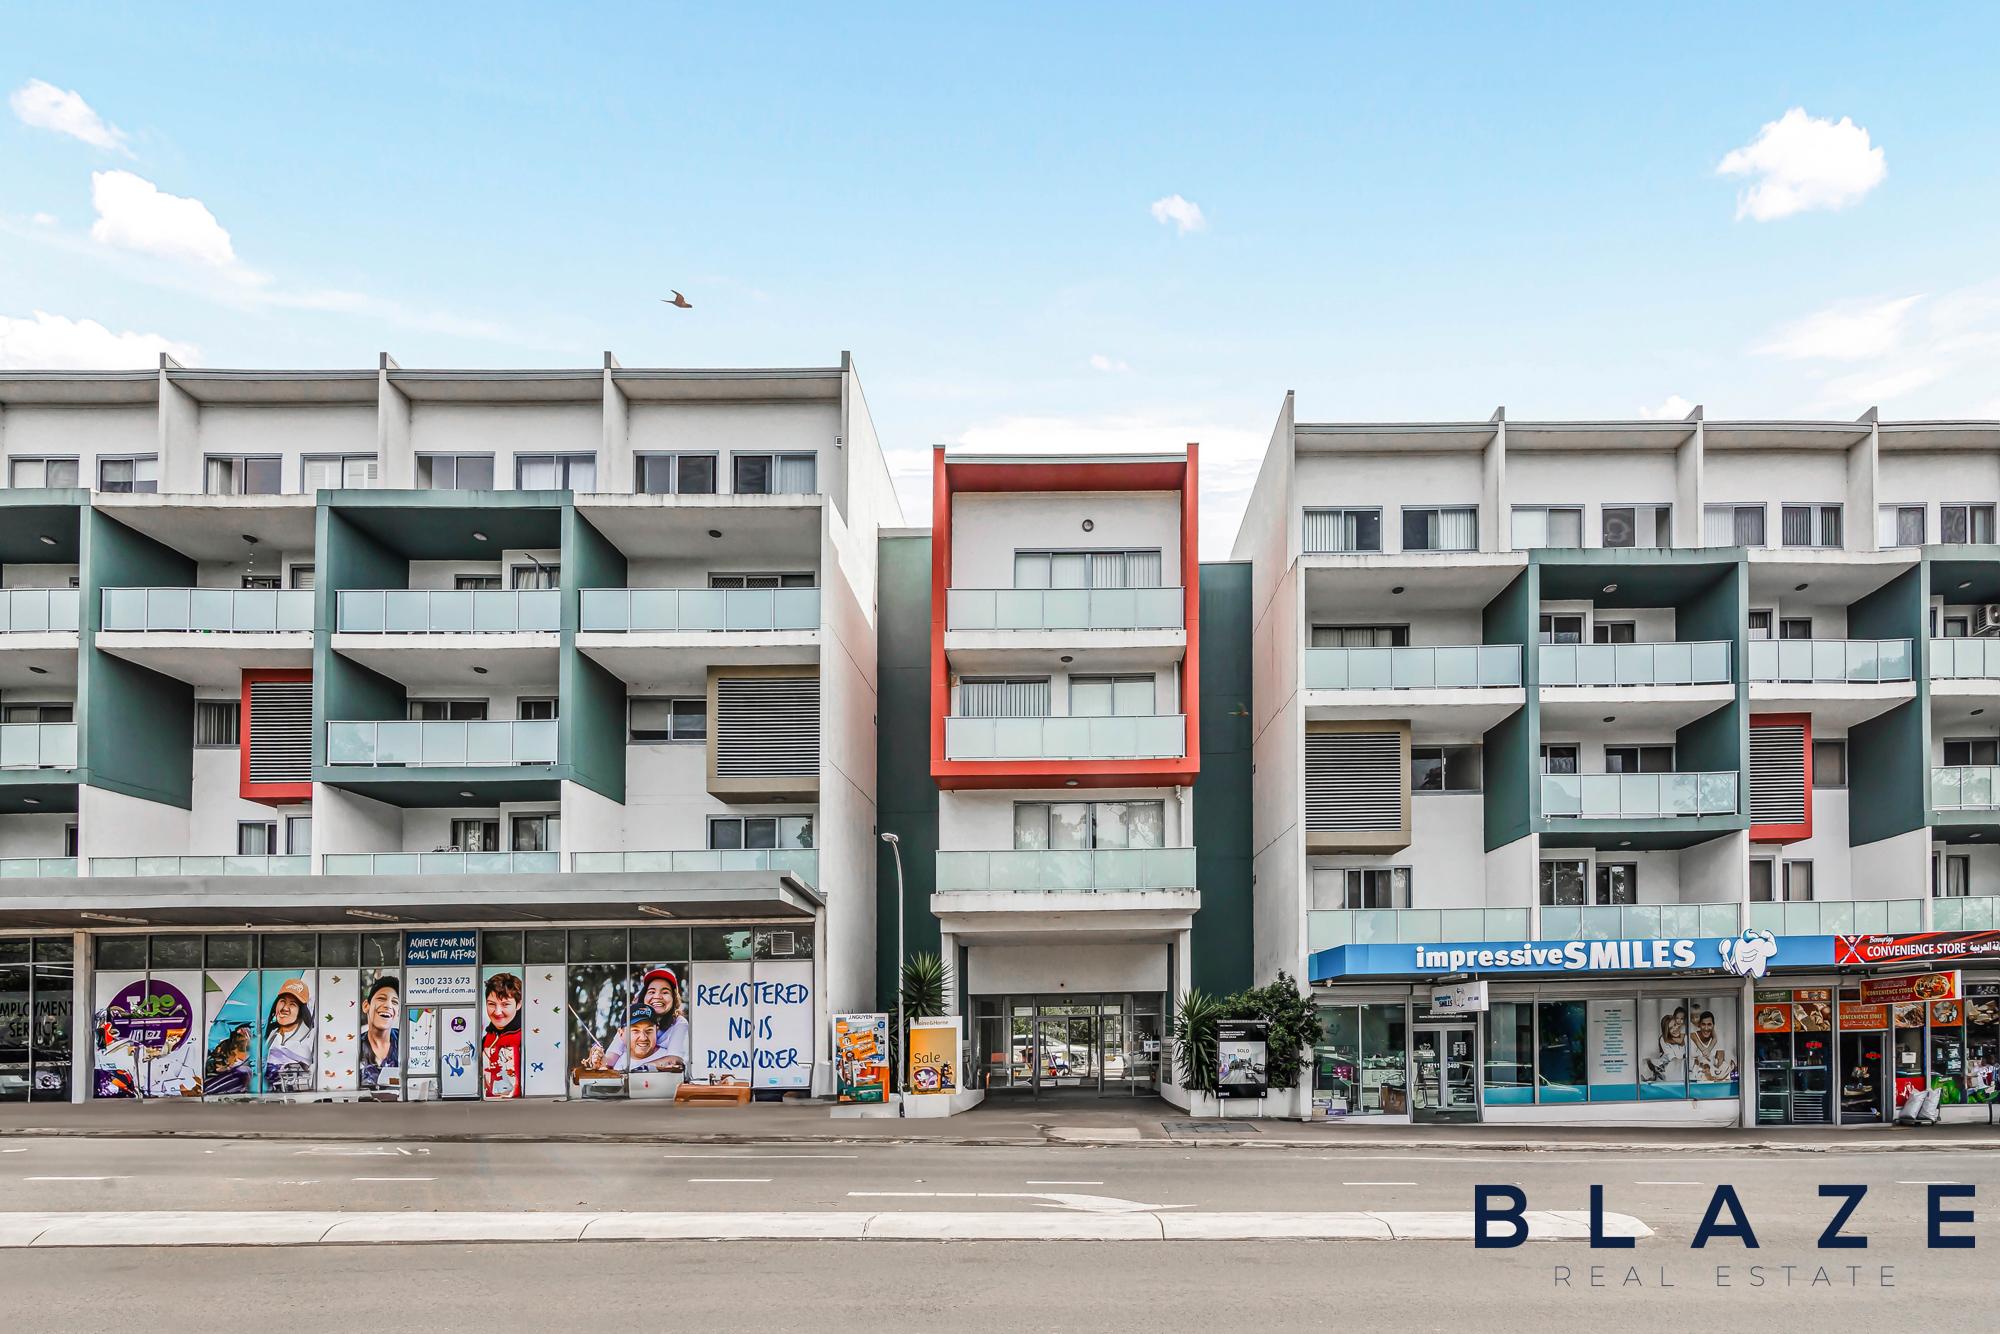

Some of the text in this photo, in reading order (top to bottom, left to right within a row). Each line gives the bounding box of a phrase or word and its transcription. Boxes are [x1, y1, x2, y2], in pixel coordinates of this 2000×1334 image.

[410, 937, 475, 948] ACHIEVE YOUR NDIS
[1867, 942, 1966, 957] CONVENIENCE STORE
[408, 949, 476, 960] GOALS WITH AFFORD
[437, 977, 453, 985] 233
[697, 981, 809, 1007] REGISTERED
[0, 1001, 73, 1017] MPLOYMENT
[729, 1016, 773, 1041] NDIS
[707, 1048, 799, 1070] PROVIDER
[914, 1052, 941, 1064] Sale
